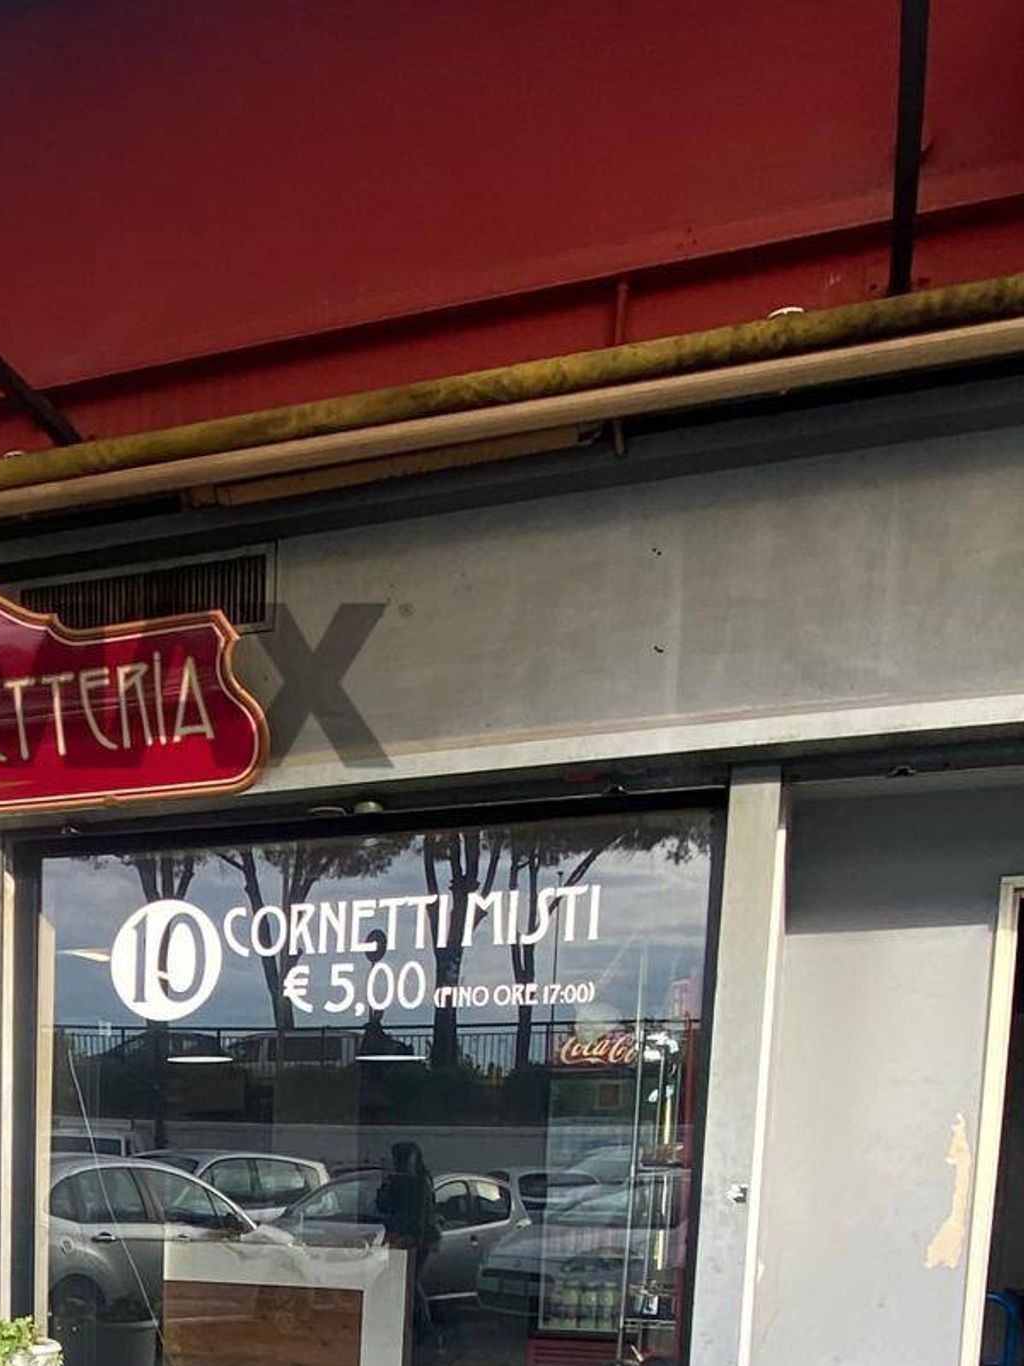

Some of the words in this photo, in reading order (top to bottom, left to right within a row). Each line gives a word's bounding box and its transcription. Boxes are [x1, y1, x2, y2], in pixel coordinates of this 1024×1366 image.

[131, 911, 207, 1004] 10
[223, 893, 449, 958] CORNETTI
[460, 884, 602, 948] MISTI
[323, 960, 426, 1017] 5,00
[433, 985, 490, 1009] (FINO
[493, 982, 539, 1007] ORE
[542, 980, 596, 1005] 17:00)
